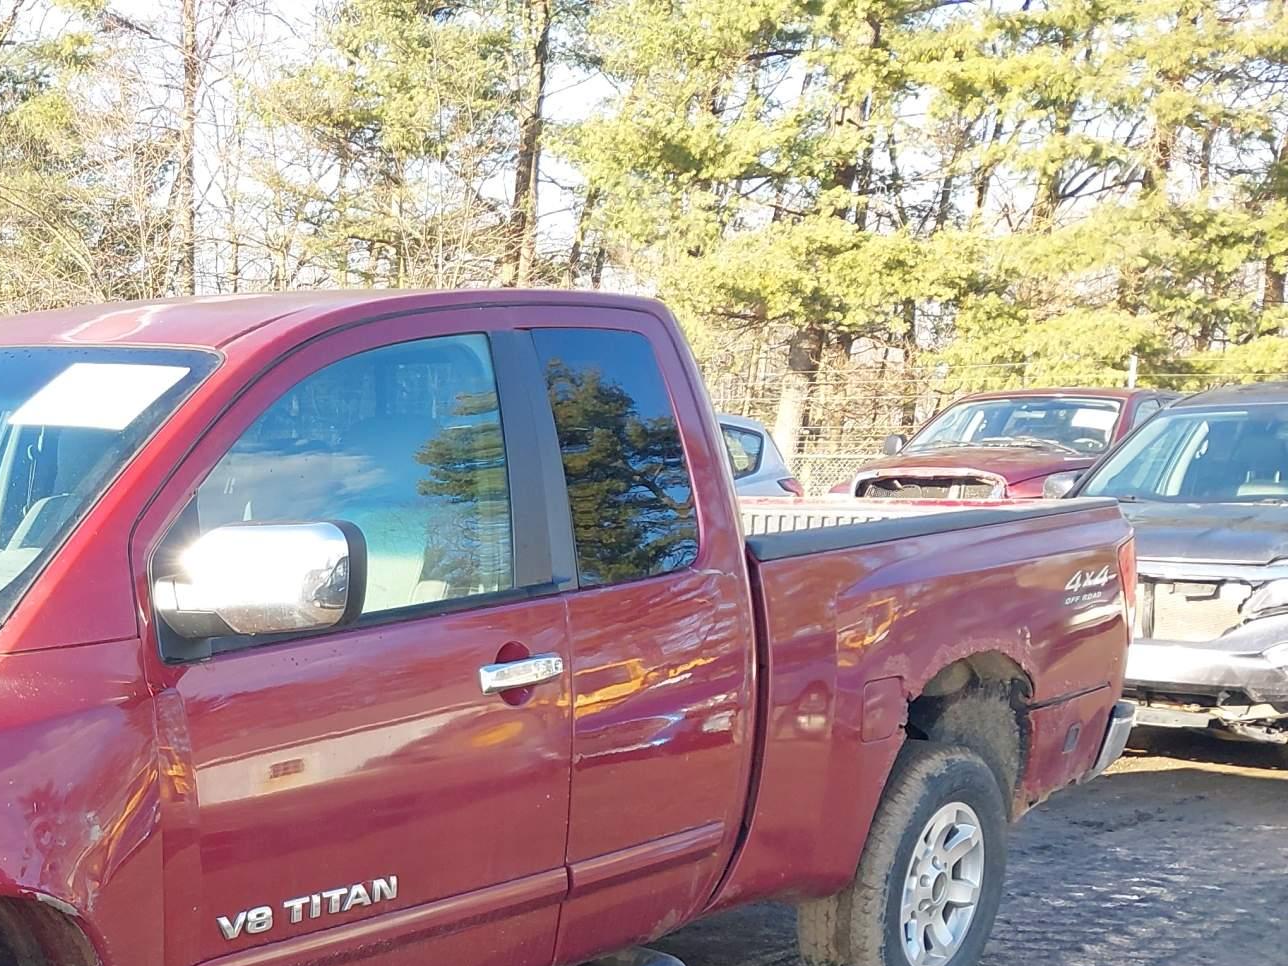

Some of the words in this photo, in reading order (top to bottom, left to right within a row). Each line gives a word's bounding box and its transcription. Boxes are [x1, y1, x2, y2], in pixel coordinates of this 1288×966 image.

[1064, 595, 1080, 605] OFF
[1082, 591, 1102, 601] ROAD
[216, 906, 273, 940] V8
[283, 875, 399, 923] TITAN
